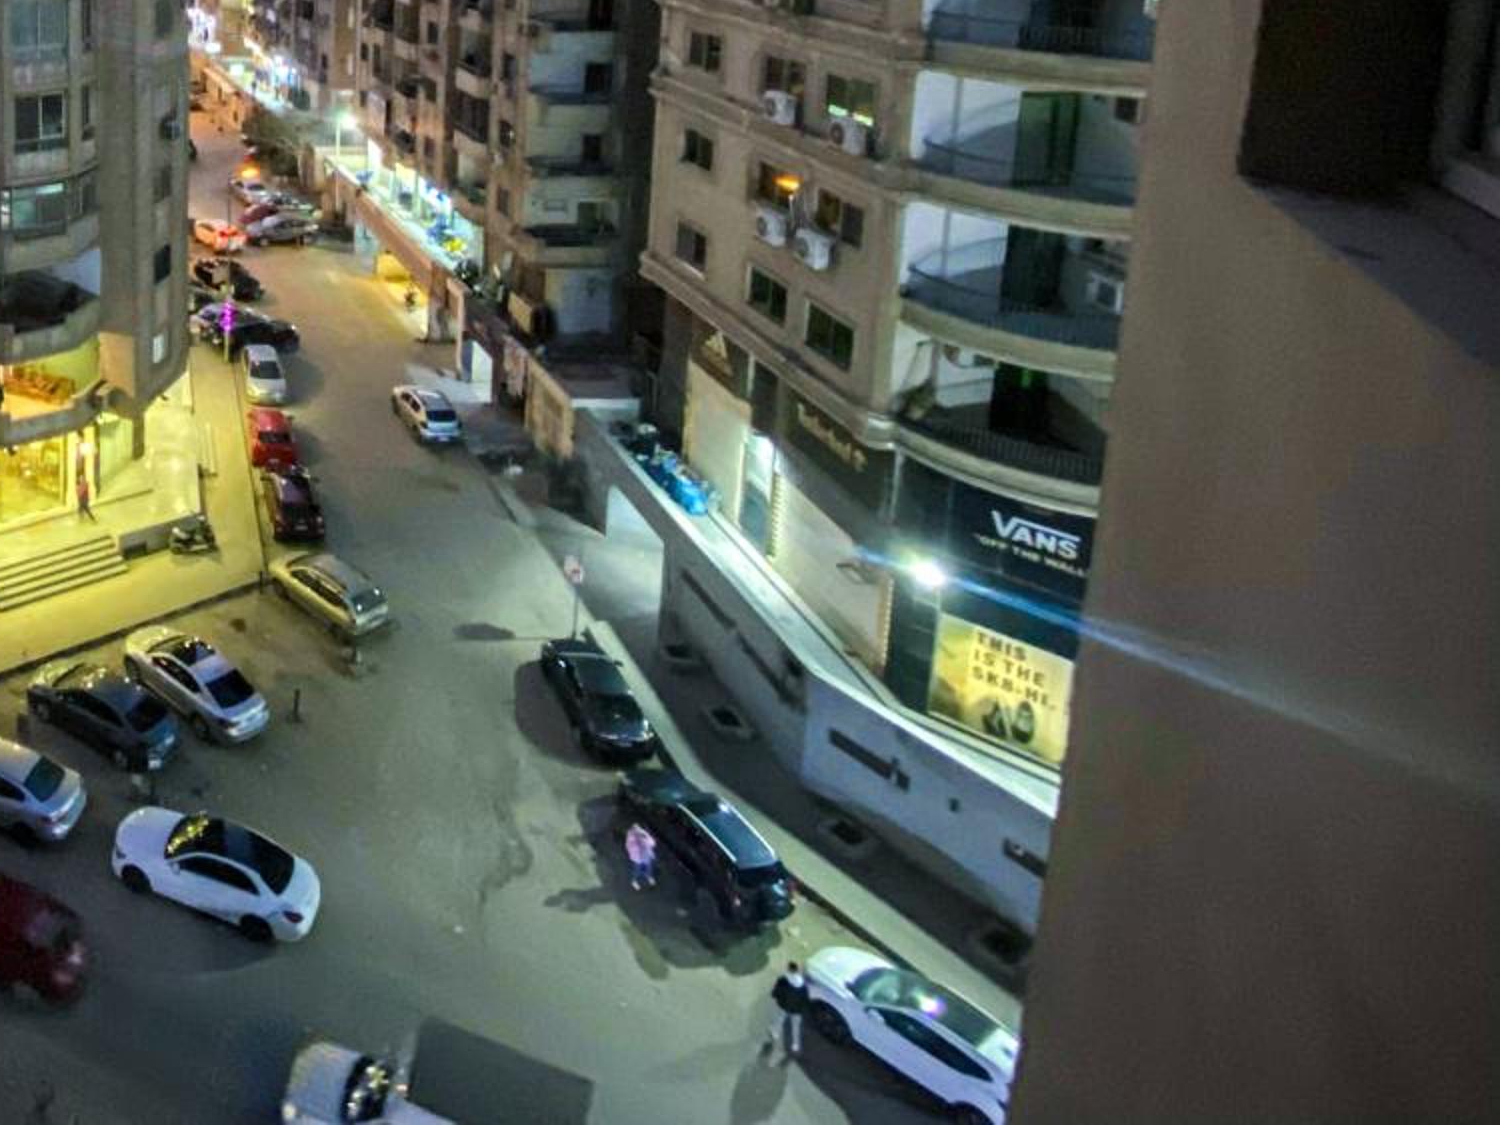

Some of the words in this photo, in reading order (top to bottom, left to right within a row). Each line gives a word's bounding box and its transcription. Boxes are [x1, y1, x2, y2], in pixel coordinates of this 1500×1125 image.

[990, 509, 1082, 560] VANS
[977, 632, 1027, 661] THIS
[974, 649, 995, 666] IS
[1003, 658, 1045, 687] THE
